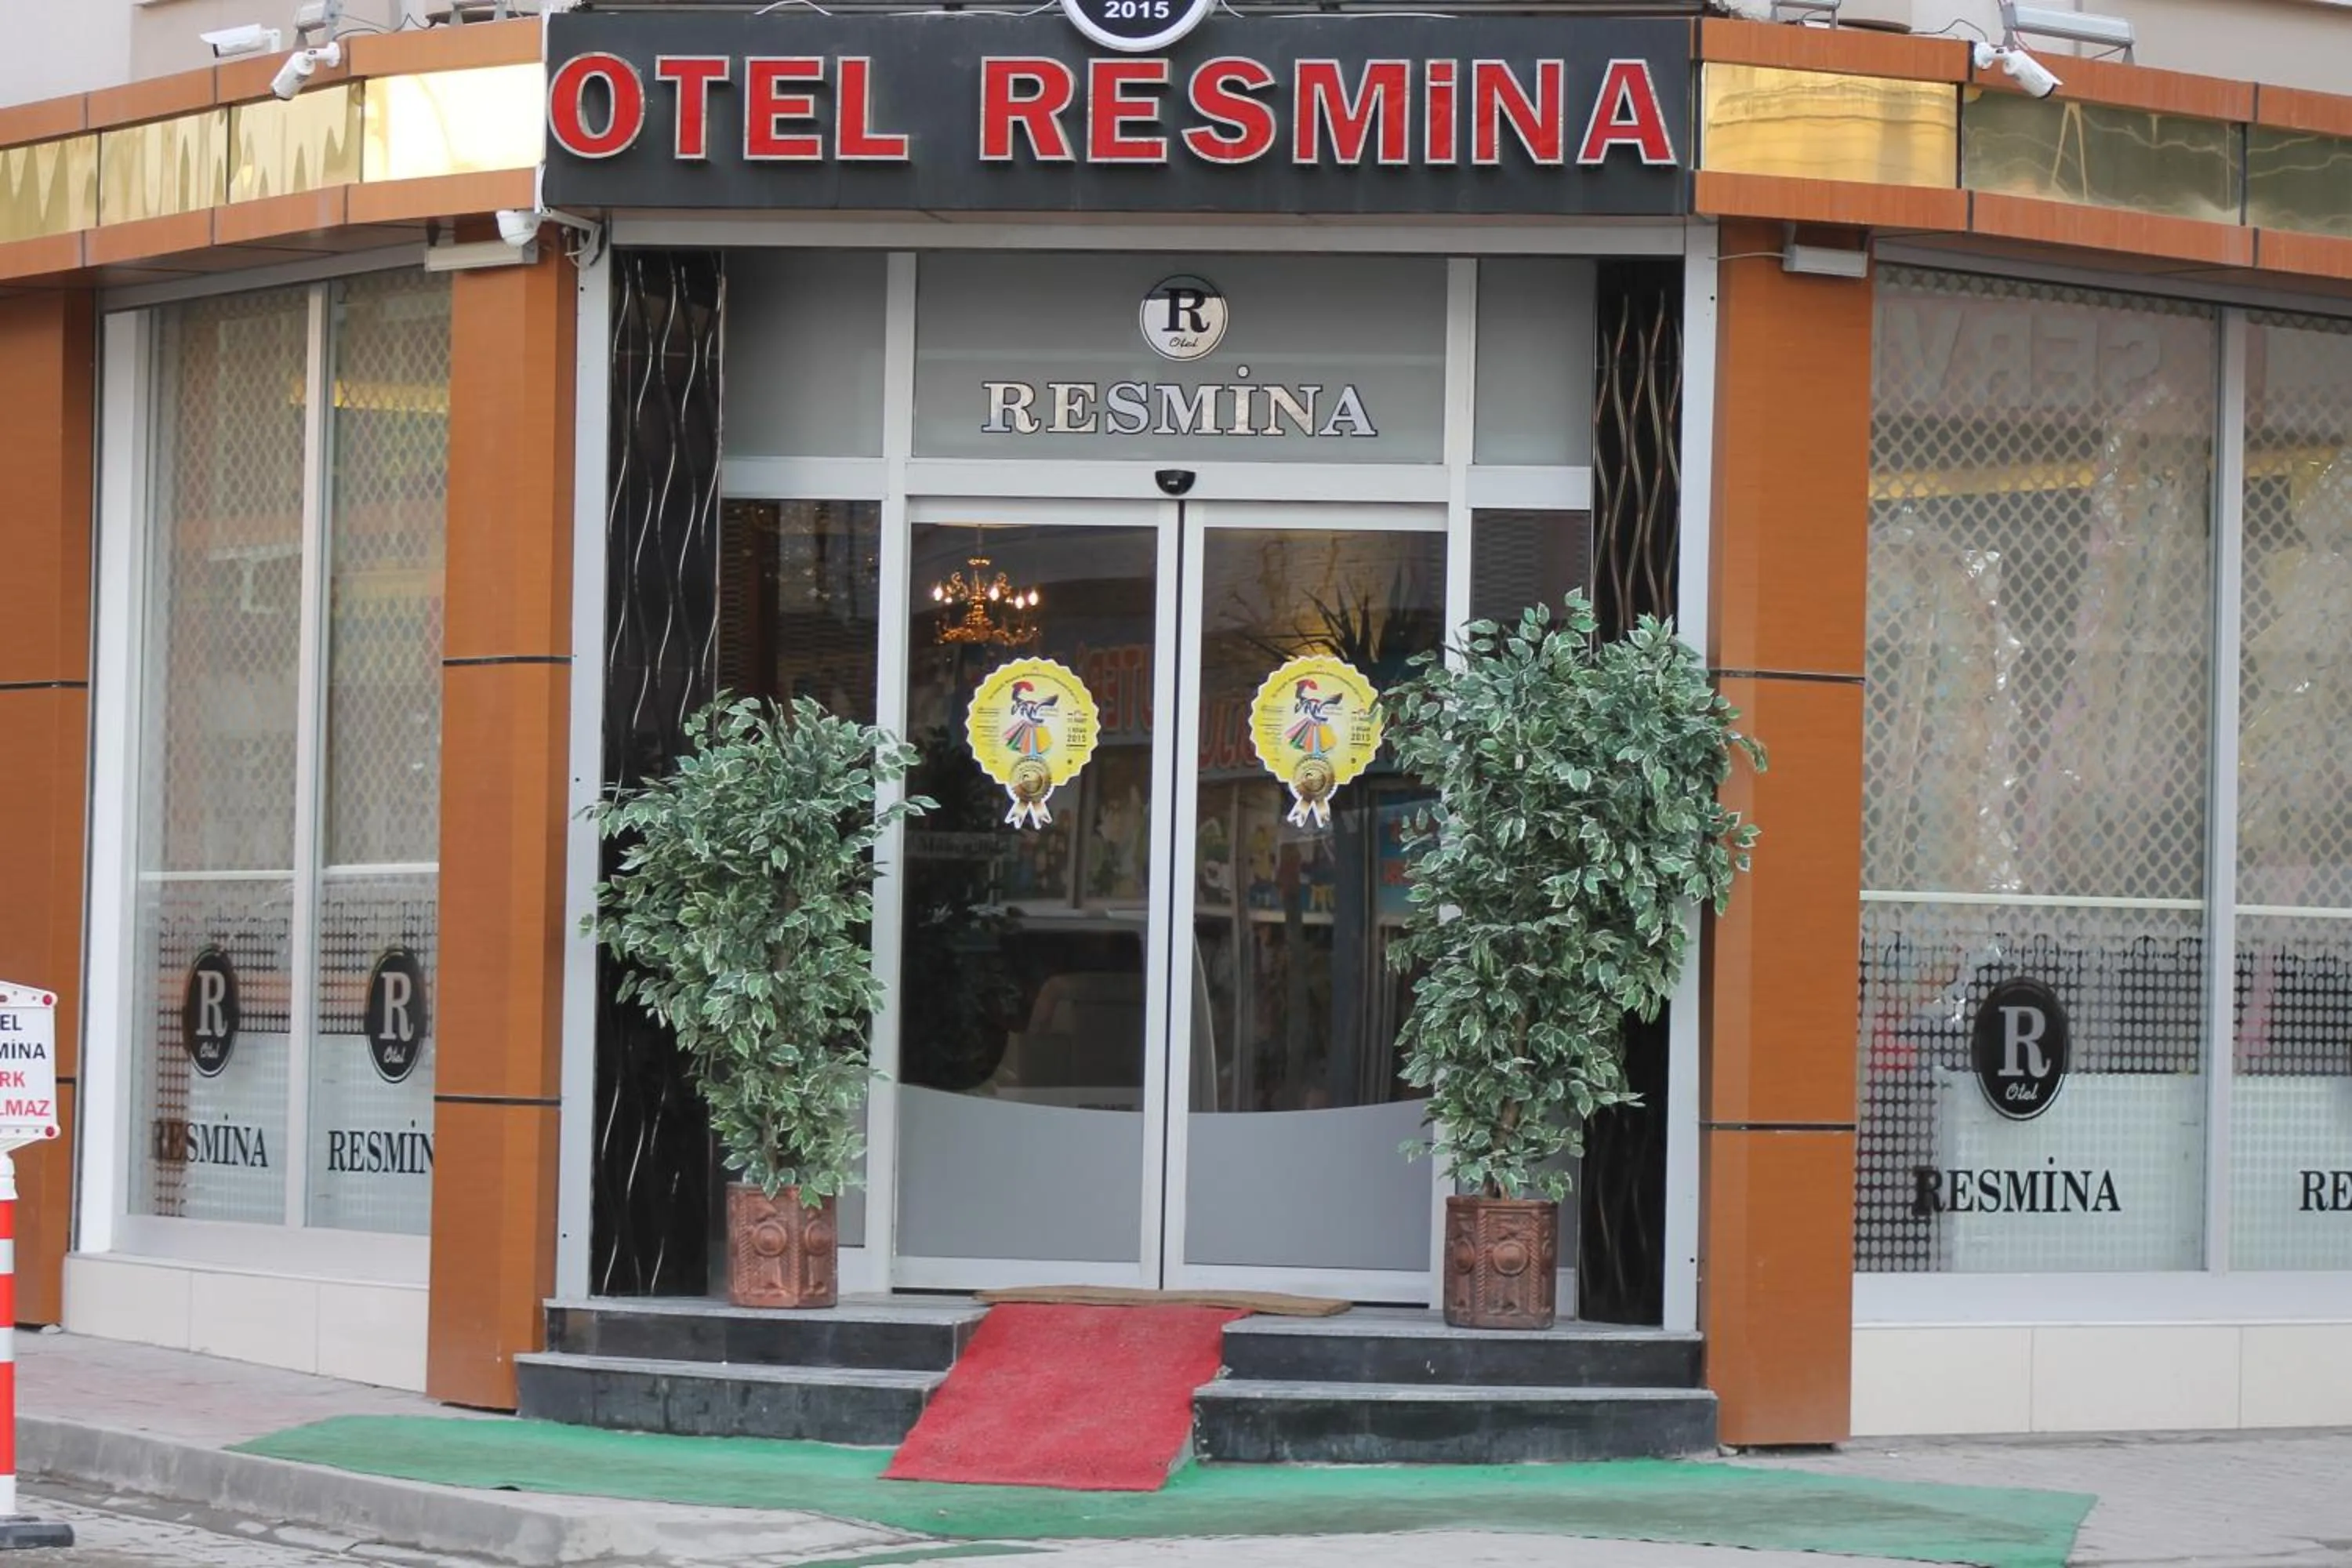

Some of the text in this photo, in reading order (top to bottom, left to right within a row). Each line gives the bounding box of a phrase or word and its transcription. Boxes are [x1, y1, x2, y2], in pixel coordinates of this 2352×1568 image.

[320, 1, 386, 19] 2015
[549, 52, 908, 160] OTEL
[1161, 287, 1210, 333] R
[1169, 336, 1198, 347] Otel
[981, 365, 1378, 437] RESMİNA
[0, 1014, 23, 1031] EL
[197, 970, 228, 1038] R
[379, 971, 415, 1042] R
[1998, 1006, 2051, 1078] R
[2005, 1082, 2039, 1100] Otel
[1912, 1156, 2122, 1214] RESMİNA
[2299, 1171, 2352, 1211] RE
